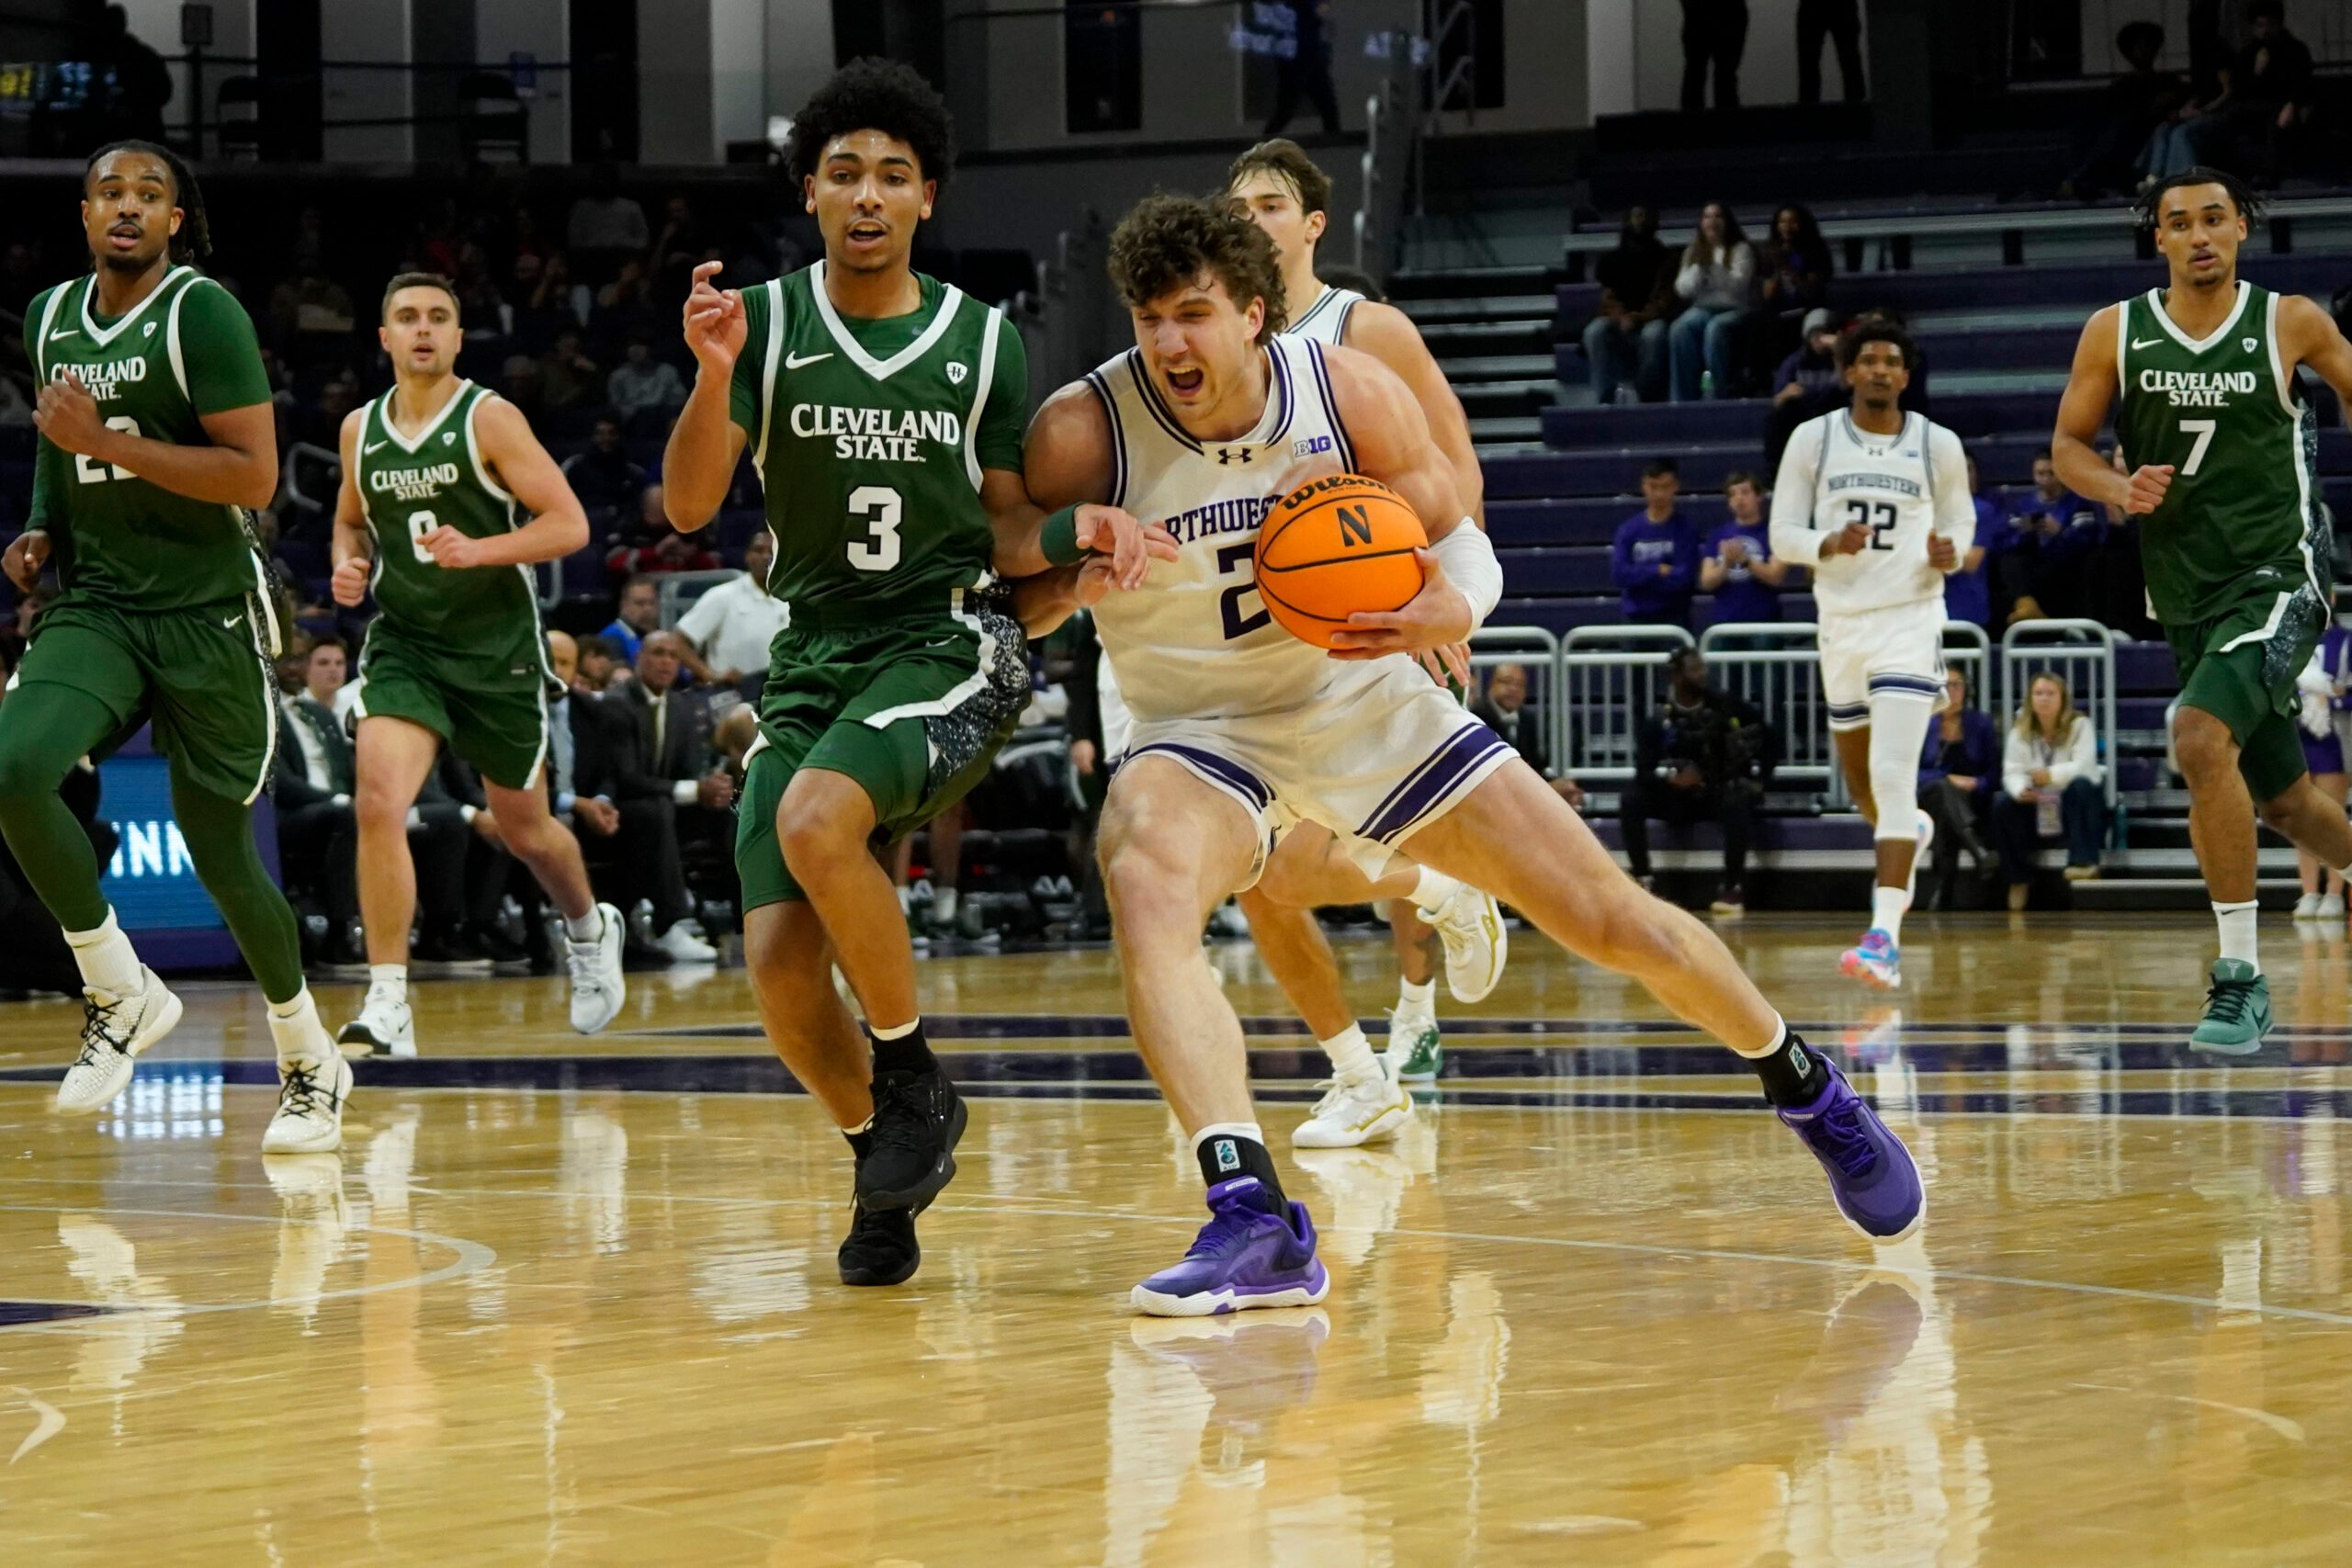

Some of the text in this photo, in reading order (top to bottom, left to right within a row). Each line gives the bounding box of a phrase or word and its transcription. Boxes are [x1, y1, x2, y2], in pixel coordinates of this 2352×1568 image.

[2140, 369, 2256, 393] CLEVELAND
[2168, 389, 2226, 406] STATE
[790, 403, 961, 446] CLEVELAND
[835, 434, 921, 462] STATE
[2178, 419, 2217, 476] 7
[370, 462, 459, 493] CLEVELAND
[394, 483, 435, 502] STATE
[846, 485, 903, 572] 3
[1336, 504, 1373, 547] N
[1216, 539, 1272, 640] 2
